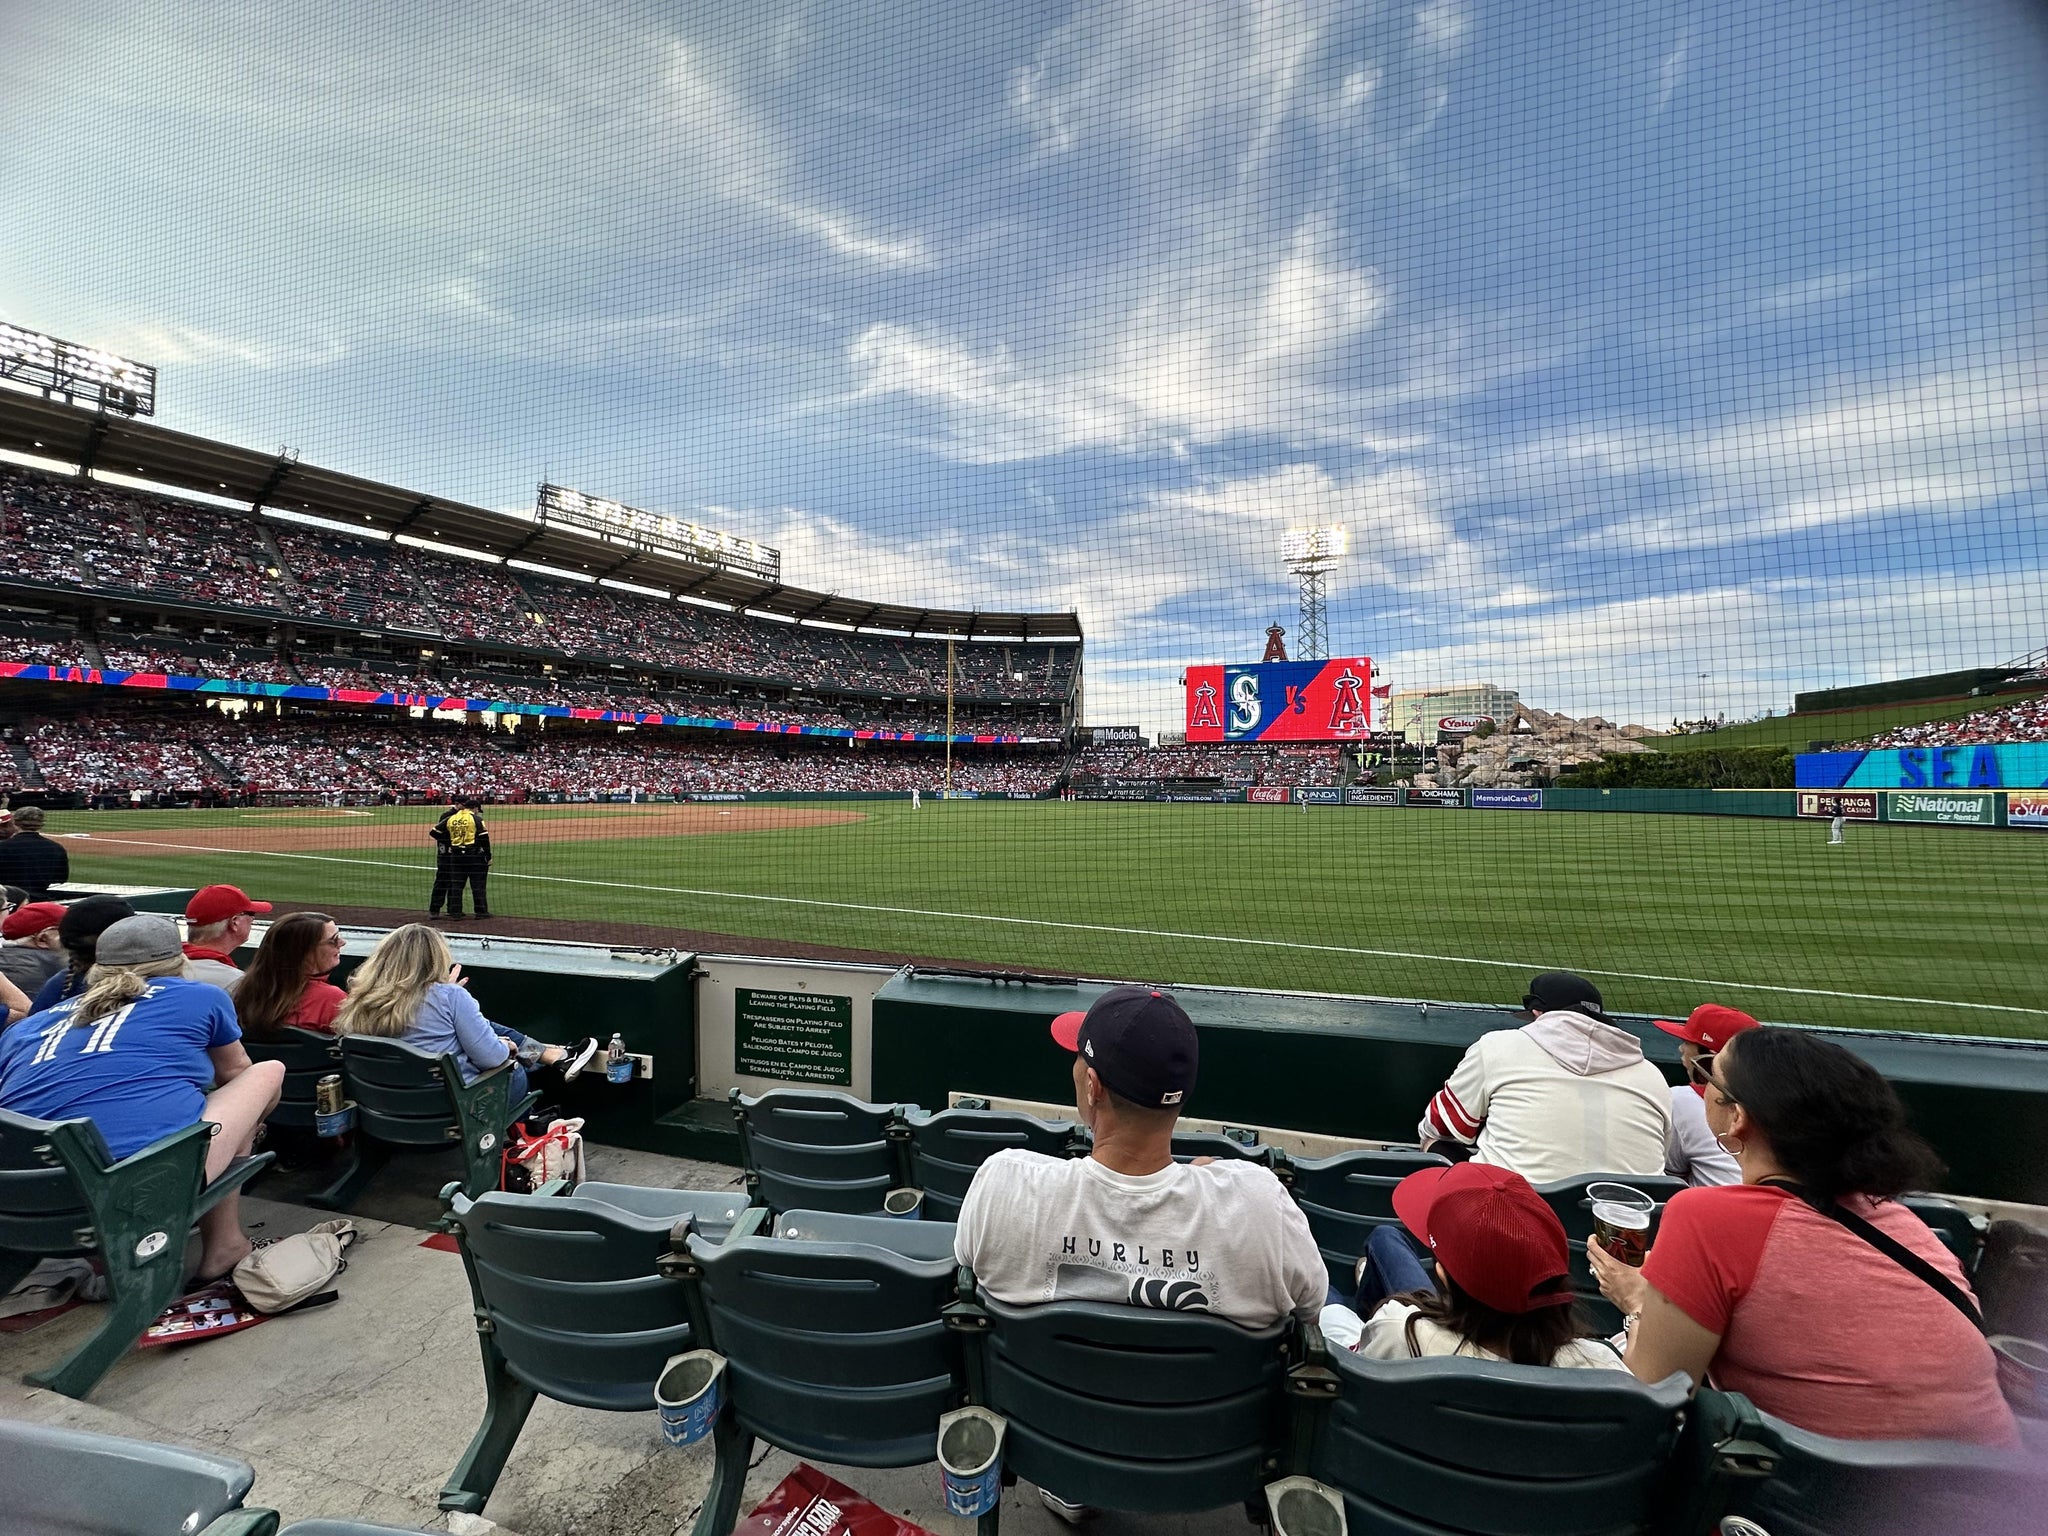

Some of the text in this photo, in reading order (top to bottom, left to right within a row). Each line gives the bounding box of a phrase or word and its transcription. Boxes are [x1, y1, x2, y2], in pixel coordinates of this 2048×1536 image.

[48, 665, 103, 684] LAA
[393, 693, 427, 707] LAA
[612, 711, 636, 723] LAA
[1105, 727, 1136, 740] Modelo
[1899, 746, 2001, 787] SEA
[1351, 794, 1393, 802] INGREDIENTS
[1476, 794, 1528, 802] MemorialCare
[1914, 797, 1983, 813] National
[1954, 814, 1980, 822] Rental
[1062, 1236, 1199, 1272] HURLEY
[806, 1498, 840, 1532] 2026
